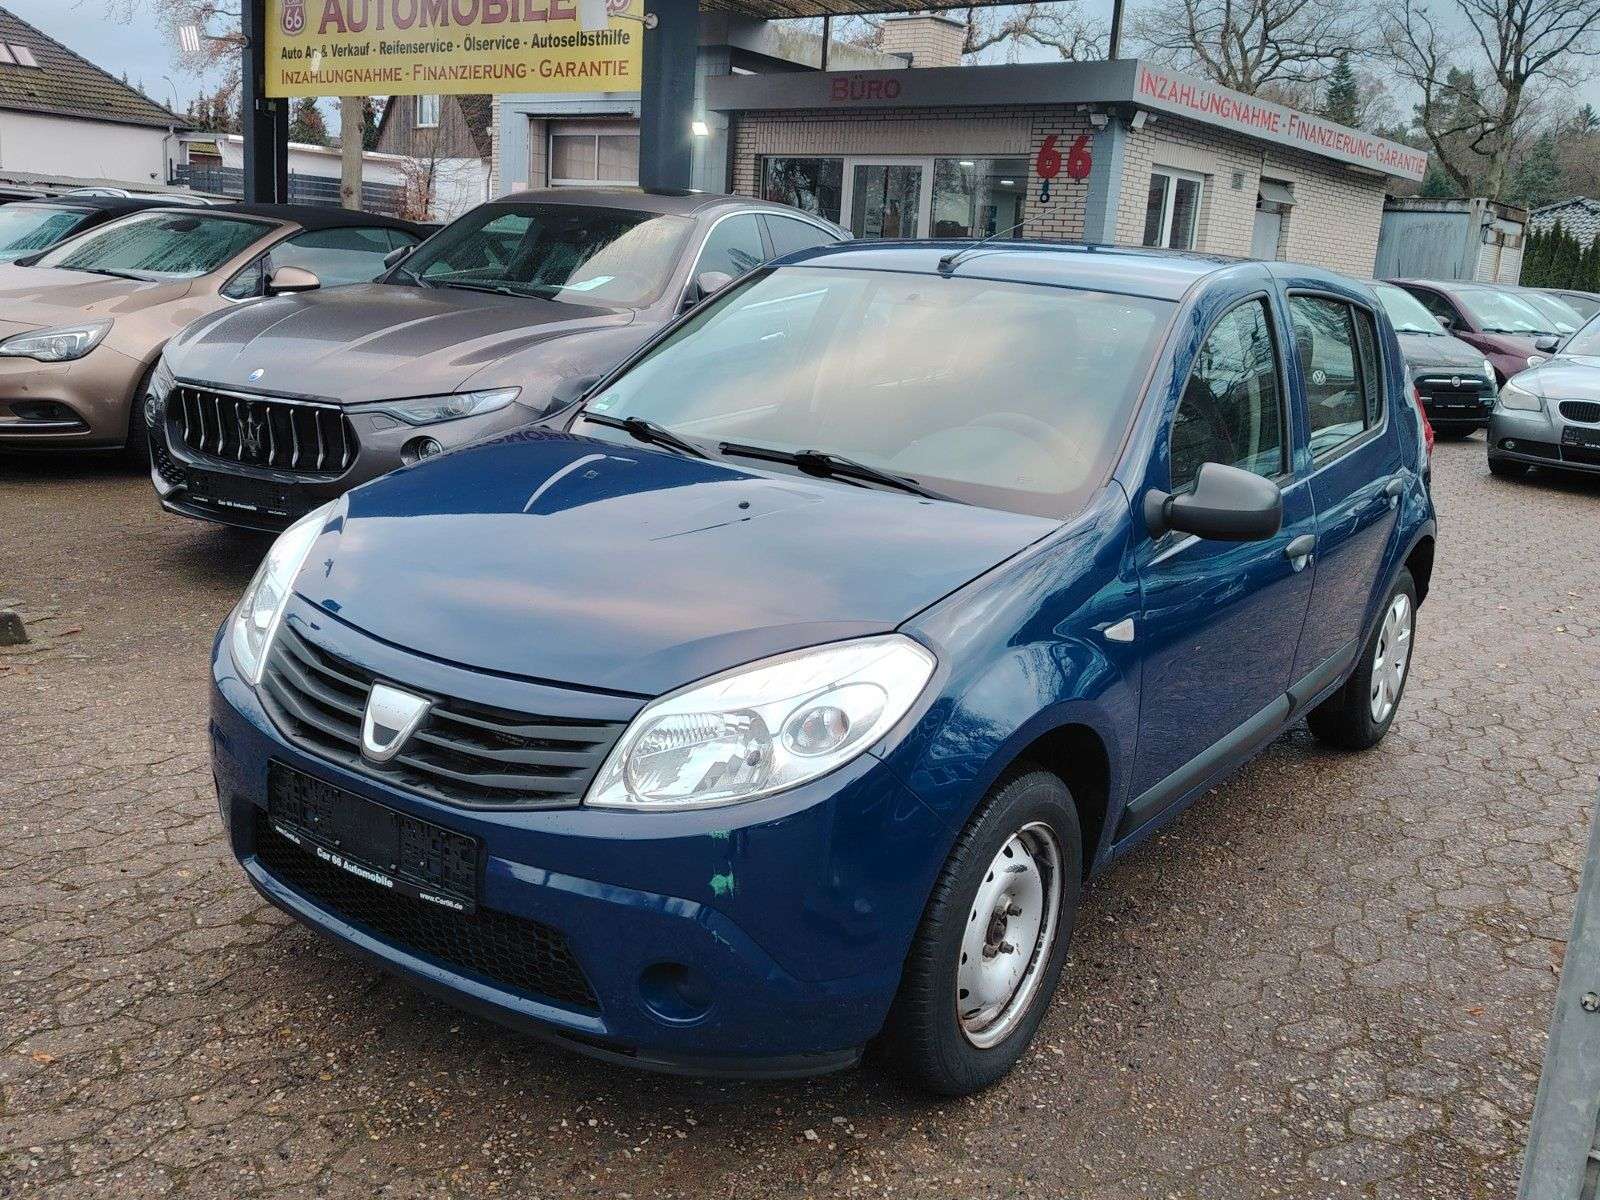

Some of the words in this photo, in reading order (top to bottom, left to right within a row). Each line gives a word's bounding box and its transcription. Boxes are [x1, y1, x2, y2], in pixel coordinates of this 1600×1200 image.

[285, 8, 304, 30] 66
[318, 0, 577, 34] AUTOMOBILE
[281, 46, 303, 60] Auto
[321, 44, 329, 58] &
[331, 42, 370, 58] Verkauf
[379, 38, 454, 56] Reifenservice
[464, 33, 520, 52] Ölservice
[531, 29, 631, 49] Autoselbsthilfe
[281, 67, 403, 85] INZAHLUNGNAHME
[413, 63, 527, 82] FINANZIERUNG
[539, 59, 630, 79] GARANTIE
[831, 75, 902, 100] BÜRO
[1140, 67, 1281, 133] INZAHLUNGNAHME
[1288, 114, 1375, 160] FINANZIERUNG
[1376, 142, 1425, 175] GARANTIE
[1036, 134, 1092, 179] 66
[317, 847, 331, 861] Car
[332, 854, 342, 867] 66
[343, 860, 394, 888] Automobile
